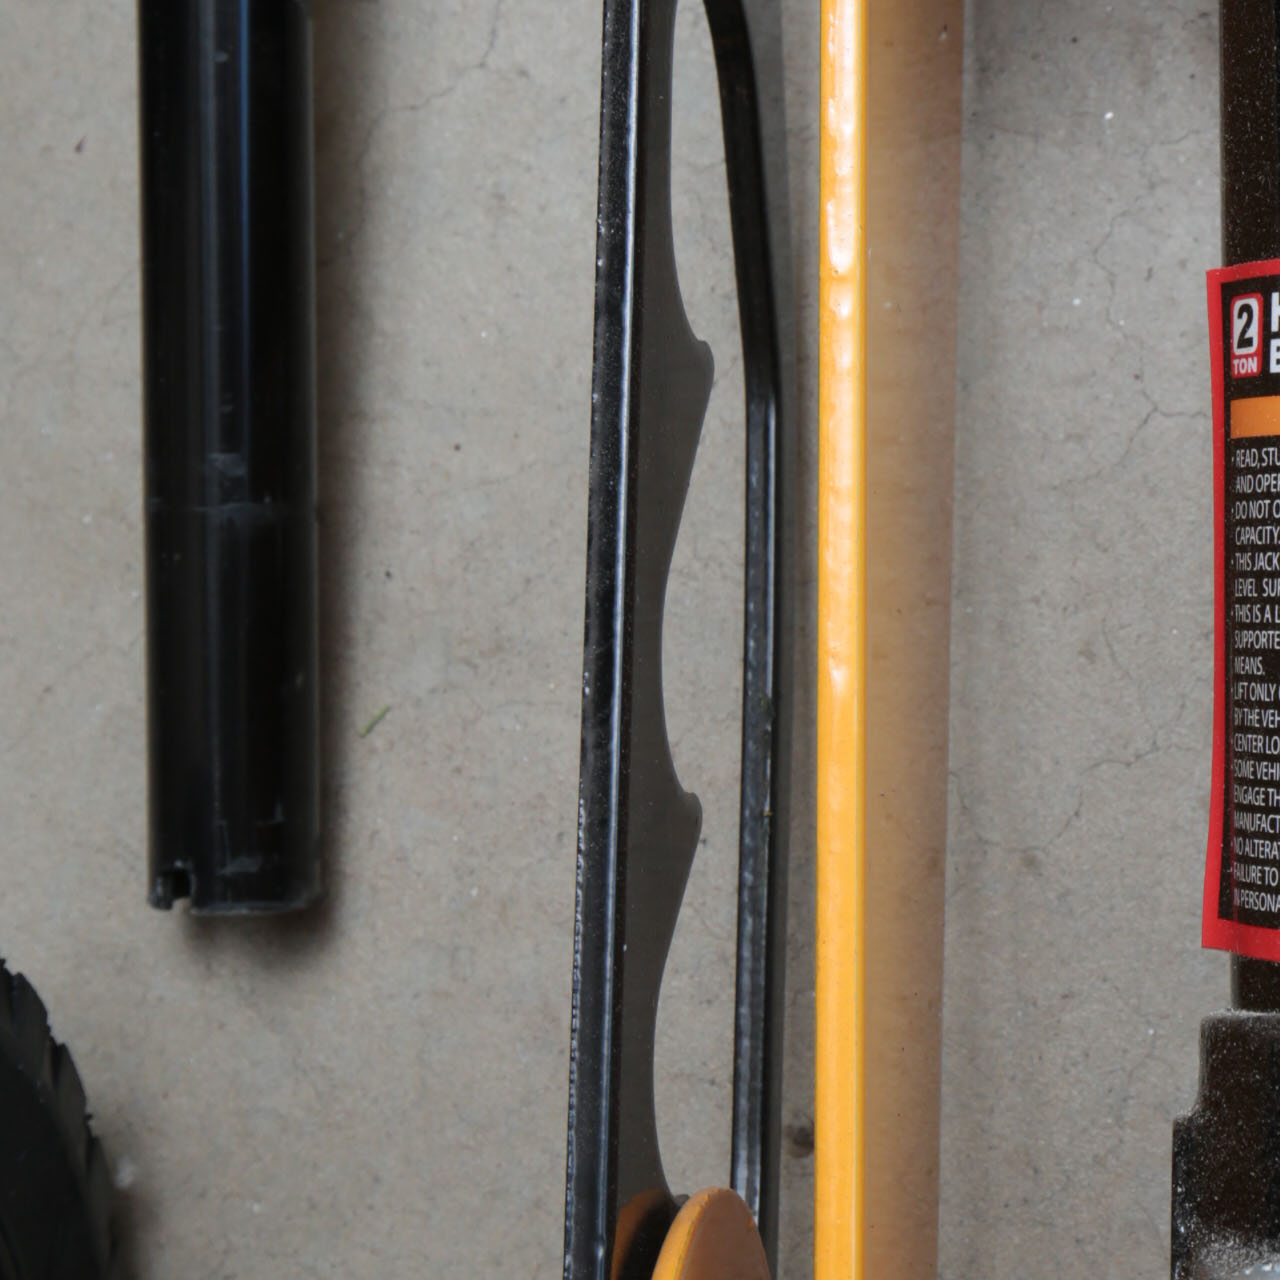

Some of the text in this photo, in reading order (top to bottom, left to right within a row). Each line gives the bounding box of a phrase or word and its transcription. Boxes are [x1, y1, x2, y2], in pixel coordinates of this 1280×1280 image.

[1236, 303, 1254, 350] 2
[1233, 356, 1258, 375] TON
[1235, 449, 1260, 471] READ,
[1235, 473, 1254, 493] AND
[1235, 501, 1247, 521] DO
[1248, 500, 1272, 521] NOT
[1235, 526, 1280, 546] CAPACITY.
[1235, 551, 1252, 571] THIS
[1253, 551, 1280, 571] JACK
[1234, 578, 1257, 597] LEVEL
[1234, 605, 1251, 624] THIS
[1251, 605, 1261, 624] IS
[1263, 605, 1272, 624] A
[1234, 656, 1264, 677] MEANS.
[1234, 683, 1248, 703] LIFT
[1248, 683, 1276, 703] ONLY
[1234, 708, 1243, 728] BY
[1243, 708, 1260, 728] THE
[1234, 732, 1263, 753] CENTER
[1234, 759, 1255, 780] SOME
[1233, 786, 1265, 807] ENGAGE
[1233, 838, 1244, 858] NO
[1233, 863, 1262, 885] FAILURE
[1262, 865, 1278, 886] TO
